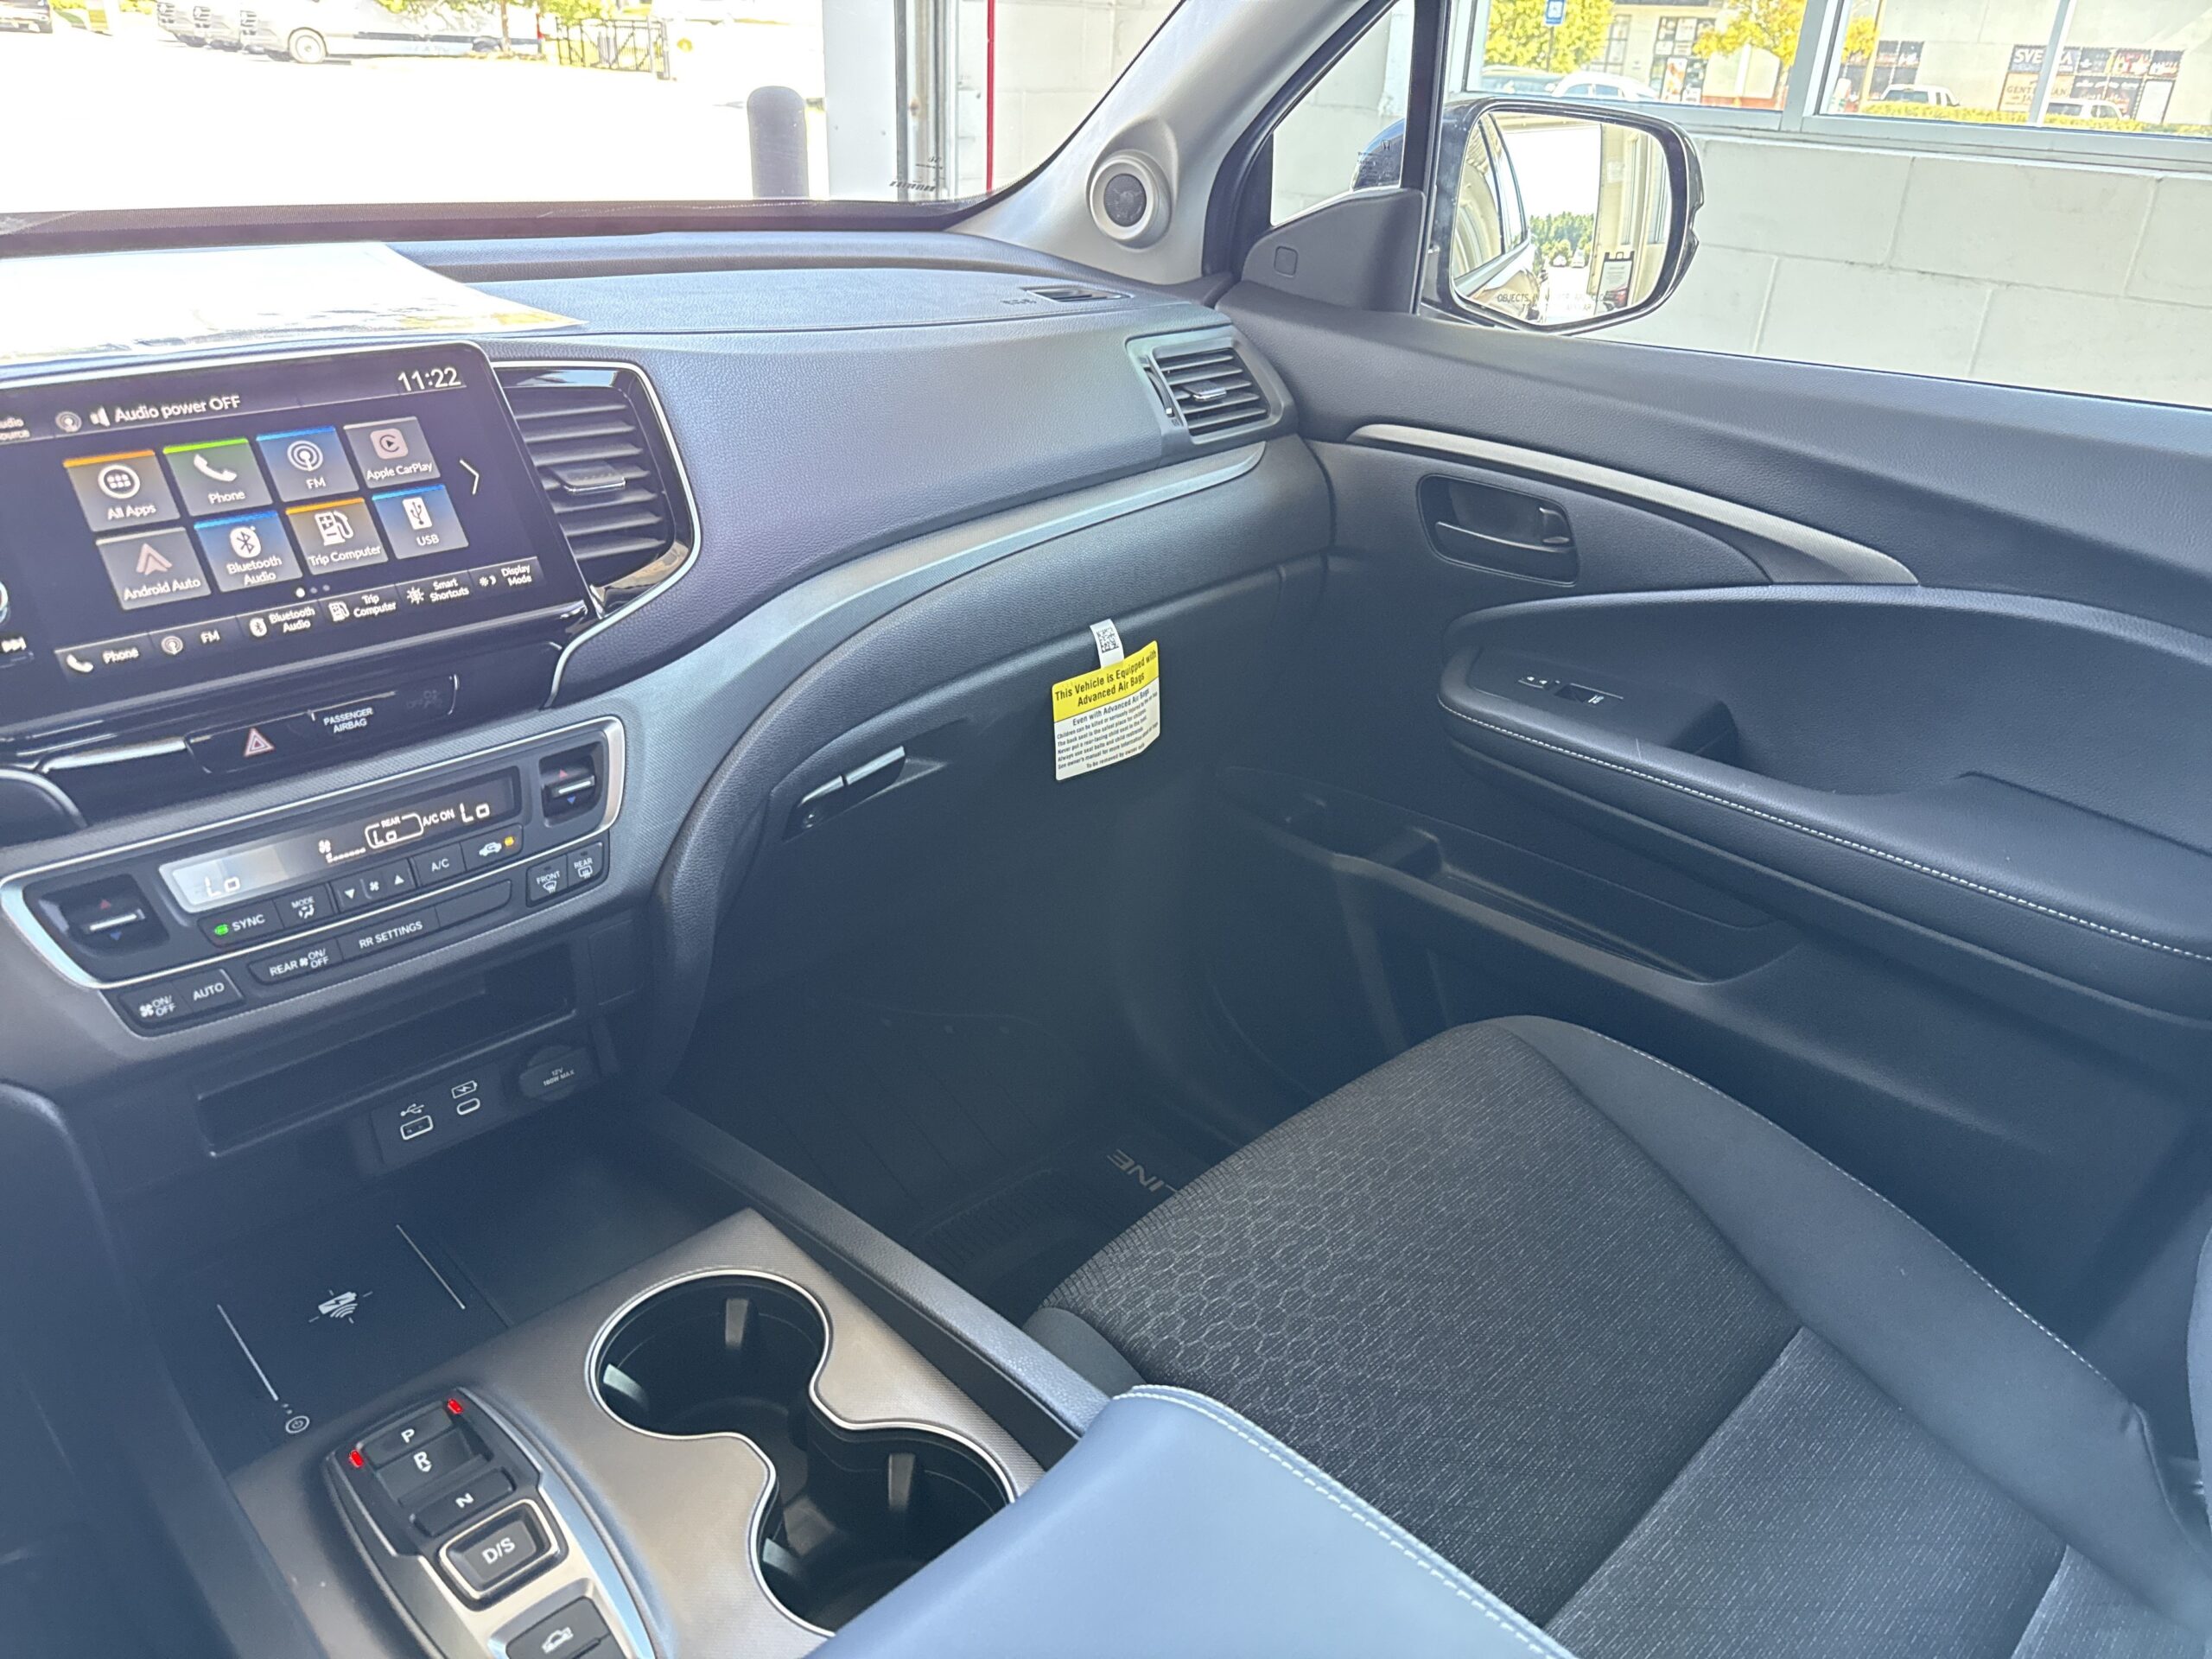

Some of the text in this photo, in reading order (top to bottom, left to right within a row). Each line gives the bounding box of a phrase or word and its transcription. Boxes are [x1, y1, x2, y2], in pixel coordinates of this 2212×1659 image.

[1497, 293, 1529, 303] OBJECTS
[398, 367, 461, 391] 11:22
[114, 395, 241, 423] Audio power OFF
[0, 416, 24, 429] udio
[0, 429, 30, 441] ource
[366, 462, 433, 481] Apple CarPlay
[306, 477, 327, 490] FM
[207, 491, 245, 505] Phone
[107, 503, 156, 520] All Apps
[416, 534, 440, 547] USB
[308, 545, 381, 567] Trip Computer
[226, 556, 283, 575] Bluetooth
[501, 563, 531, 579] Display
[243, 571, 276, 587] Audio
[433, 578, 459, 592] Smart
[507, 574, 532, 587] Mode
[123, 577, 201, 601] Android Auto
[429, 587, 470, 602] Shortcuts
[362, 594, 380, 607] Trip
[269, 605, 315, 625] Bluetooth
[353, 601, 397, 619] Computer
[283, 620, 311, 633] Audio
[200, 630, 220, 644] FM
[103, 647, 139, 664] Phone
[1055, 650, 1157, 701] This Vehicle is Equipped with
[1077, 672, 1145, 707] Advanced Air Bags
[323, 707, 374, 726] PASSENGER
[1072, 715, 1088, 726] Even
[1089, 710, 1102, 721] with
[1103, 698, 1131, 715] Advanced
[333, 718, 367, 734] AIRBAG
[423, 809, 455, 827] A/C ON
[460, 803, 490, 823] Lo
[380, 816, 401, 829] REAR
[372, 830, 397, 845] Lo
[431, 858, 450, 872] A/C
[574, 857, 593, 869] REAR
[537, 870, 561, 885] FRONT
[205, 876, 241, 898] Lo
[291, 896, 315, 909] MODE
[232, 914, 265, 931] SYNC
[359, 920, 423, 949] RR SETTINGS
[308, 949, 327, 960] ON/
[269, 961, 298, 976] REAR
[311, 957, 329, 969] OFF
[193, 982, 225, 1001] AUTO
[151, 995, 173, 1008] ON/
[155, 1004, 176, 1016] OFF
[560, 1069, 575, 1079] MAX
[401, 1428, 415, 1443] P
[413, 1451, 431, 1470] R
[455, 1493, 474, 1508] N
[481, 1537, 516, 1565] D/S
